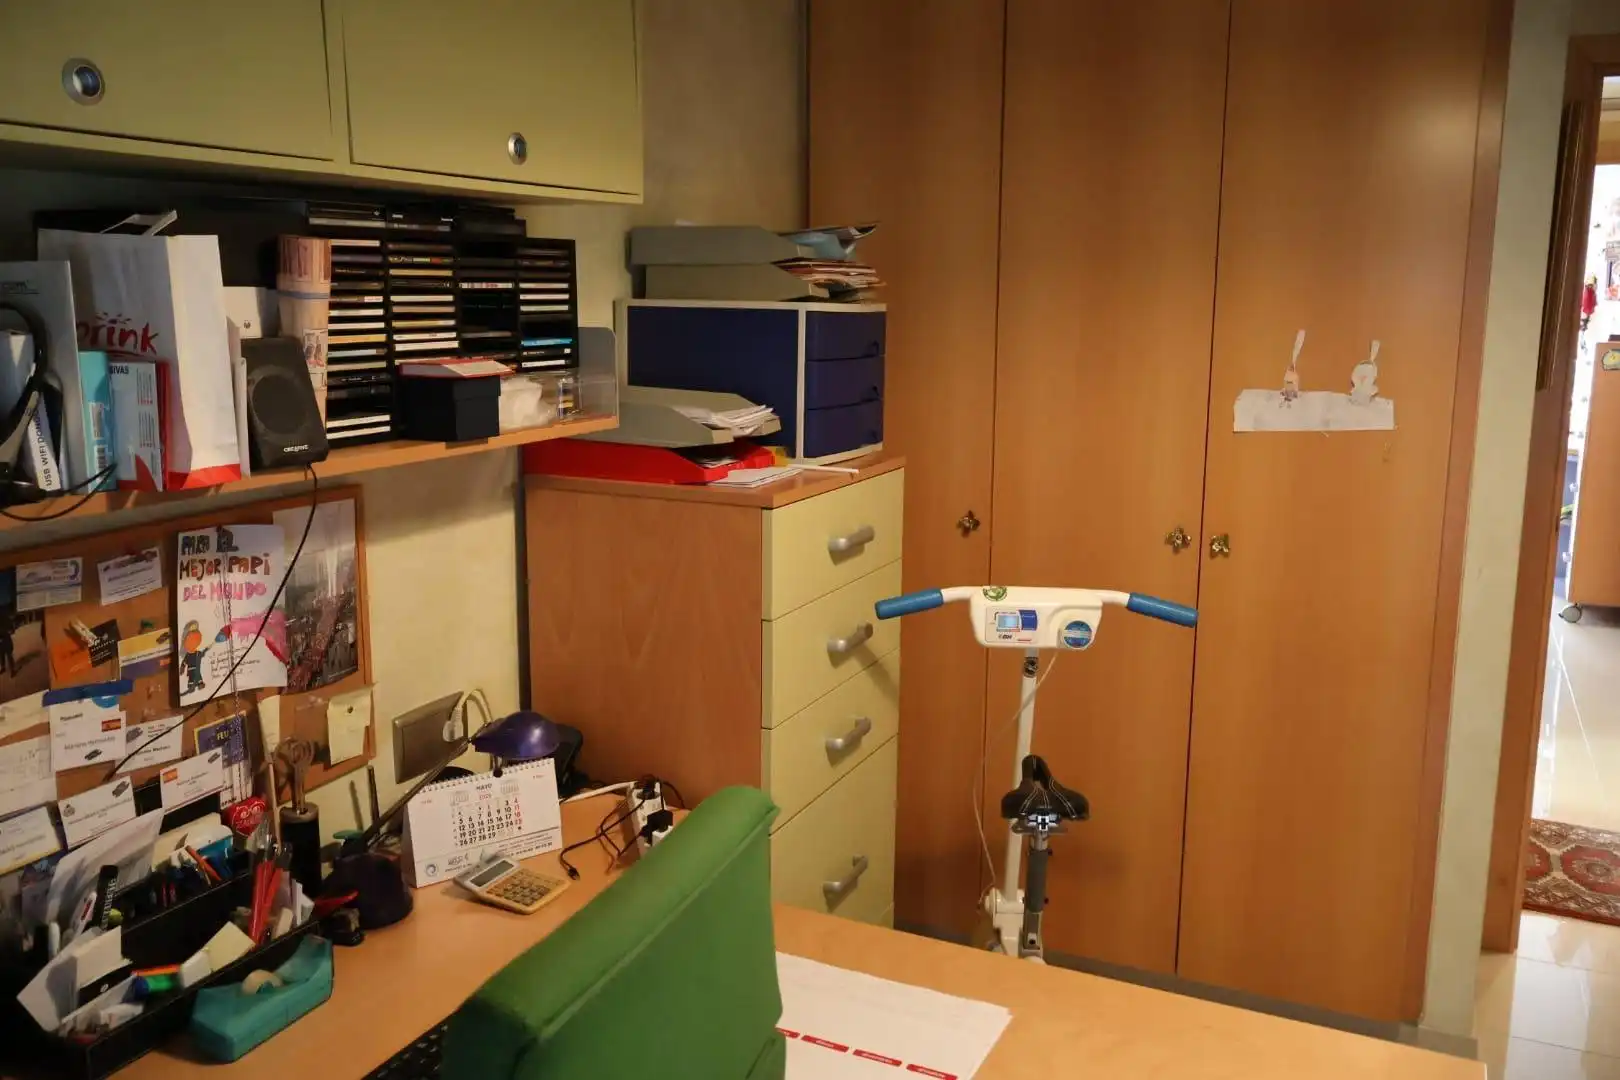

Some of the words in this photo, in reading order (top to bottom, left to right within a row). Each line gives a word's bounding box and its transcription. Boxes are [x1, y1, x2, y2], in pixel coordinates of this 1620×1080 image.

[39, 445, 49, 466] WIFI
[43, 468, 53, 486] USB
[179, 557, 222, 581] MEJOR
[182, 583, 206, 602] DEL
[210, 581, 267, 602] MUNDO
